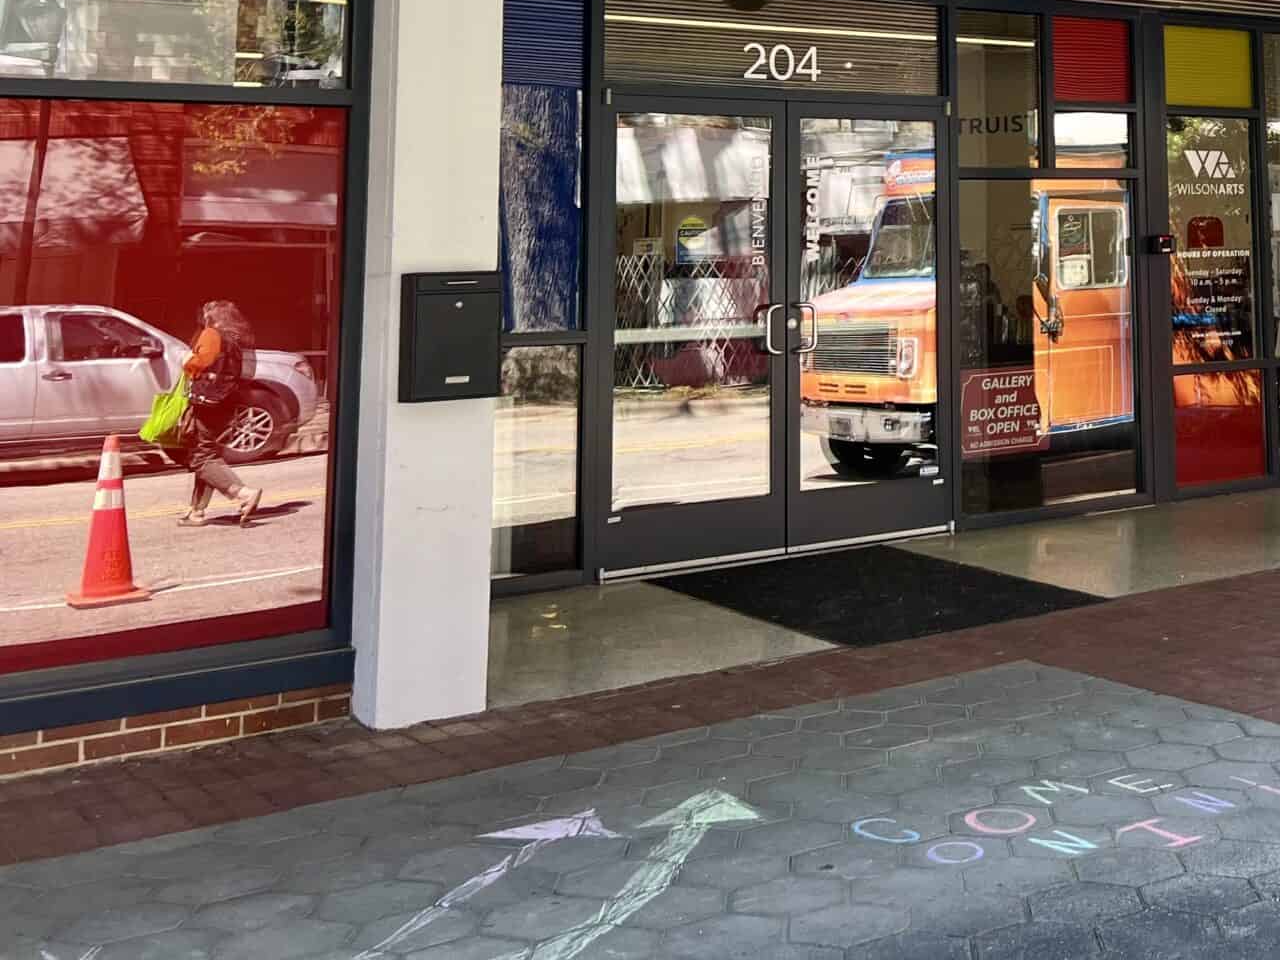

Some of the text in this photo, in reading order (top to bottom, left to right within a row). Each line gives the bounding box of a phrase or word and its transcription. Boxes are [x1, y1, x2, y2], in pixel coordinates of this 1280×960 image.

[743, 42, 821, 82] 204
[958, 113, 1030, 135] TRUIS
[1176, 183, 1245, 196] WILSONARTS
[751, 156, 766, 265] BIENVENDO
[806, 154, 820, 262] WELCOME
[1213, 249, 1250, 257] OPERATION
[982, 375, 1032, 390] GALLERY
[995, 391, 1018, 404] and
[970, 404, 1039, 421] BOX OFFICE
[986, 420, 1020, 434] OPEN
[851, 773, 1174, 843] COME
[926, 830, 1099, 864] ON
